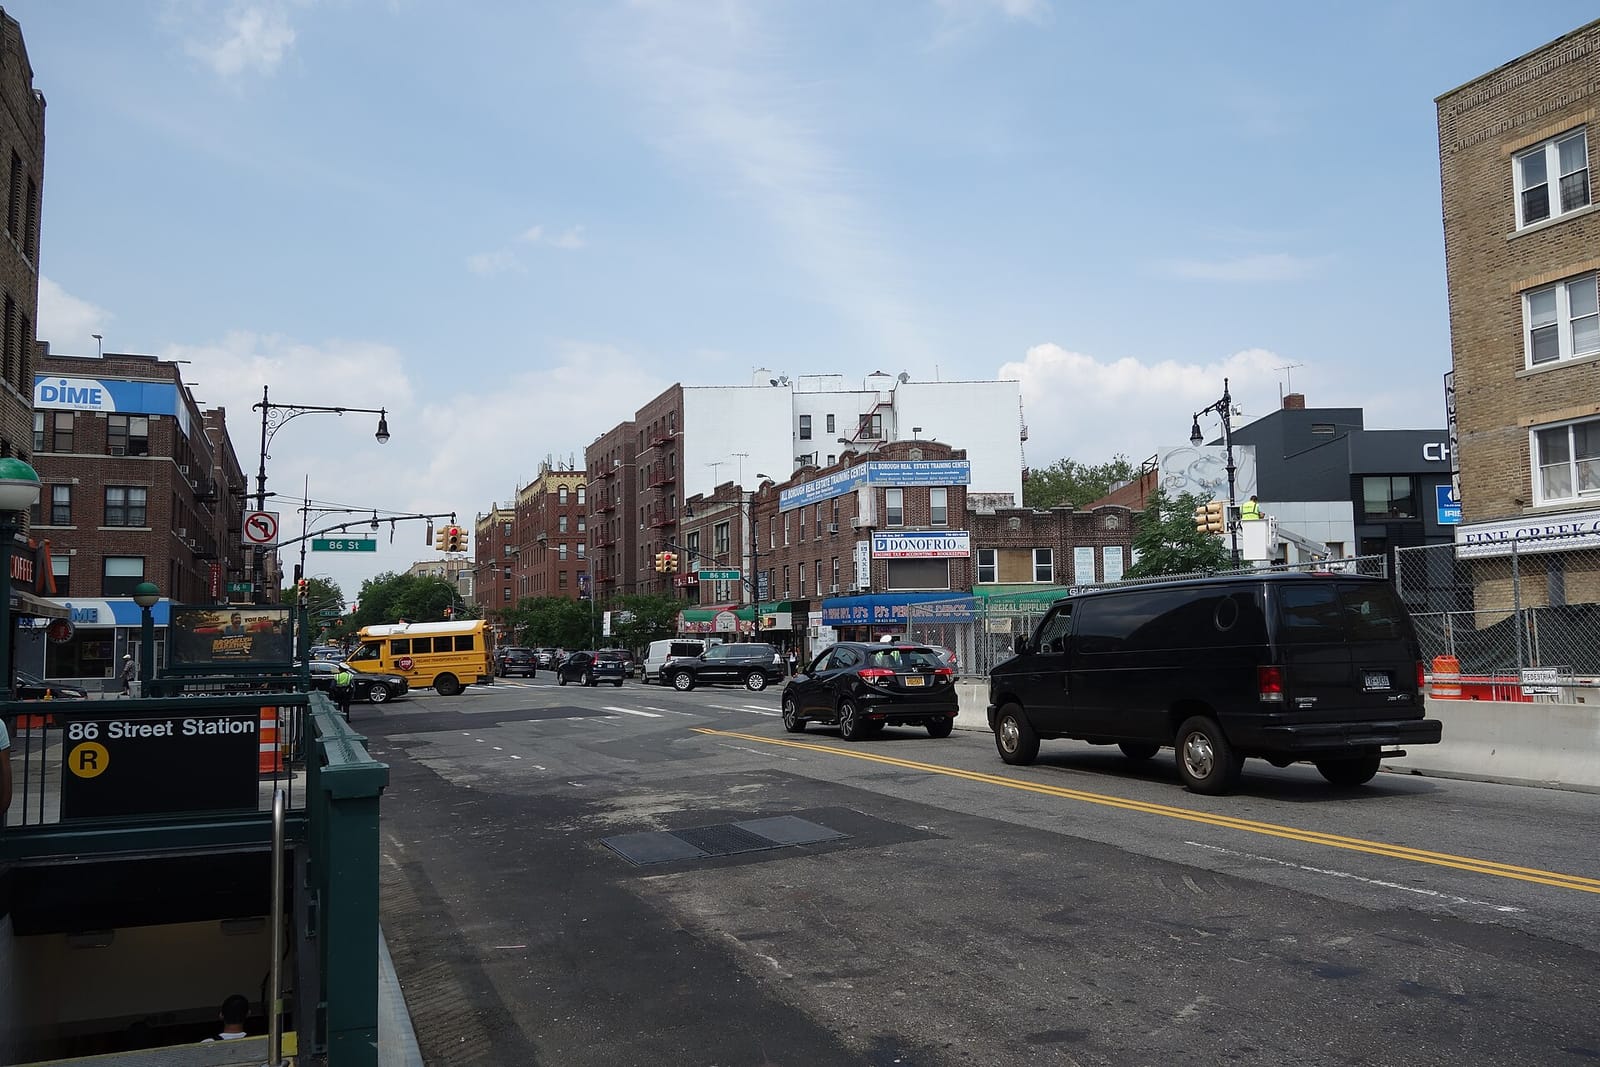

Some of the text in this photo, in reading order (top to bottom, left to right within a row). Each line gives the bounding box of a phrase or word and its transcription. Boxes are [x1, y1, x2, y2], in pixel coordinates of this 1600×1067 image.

[914, 462, 930, 470] ESTATE
[788, 485, 805, 499] BOROUGH
[806, 482, 816, 494] REAL
[816, 478, 830, 491] ESTATE
[831, 470, 850, 486] TRAINING
[850, 463, 867, 479] CENTER
[329, 541, 359, 550] 86 St
[890, 539, 956, 550] DONOFRIO
[1466, 531, 1509, 547] FINE
[10, 555, 33, 582] COFFEE
[874, 605, 889, 618] PJ's
[1019, 603, 1049, 611] SUPPLIES
[1524, 673, 1555, 681] PEDESTRIAN
[68, 718, 255, 740] 86 Street Station
[79, 750, 98, 770] R
